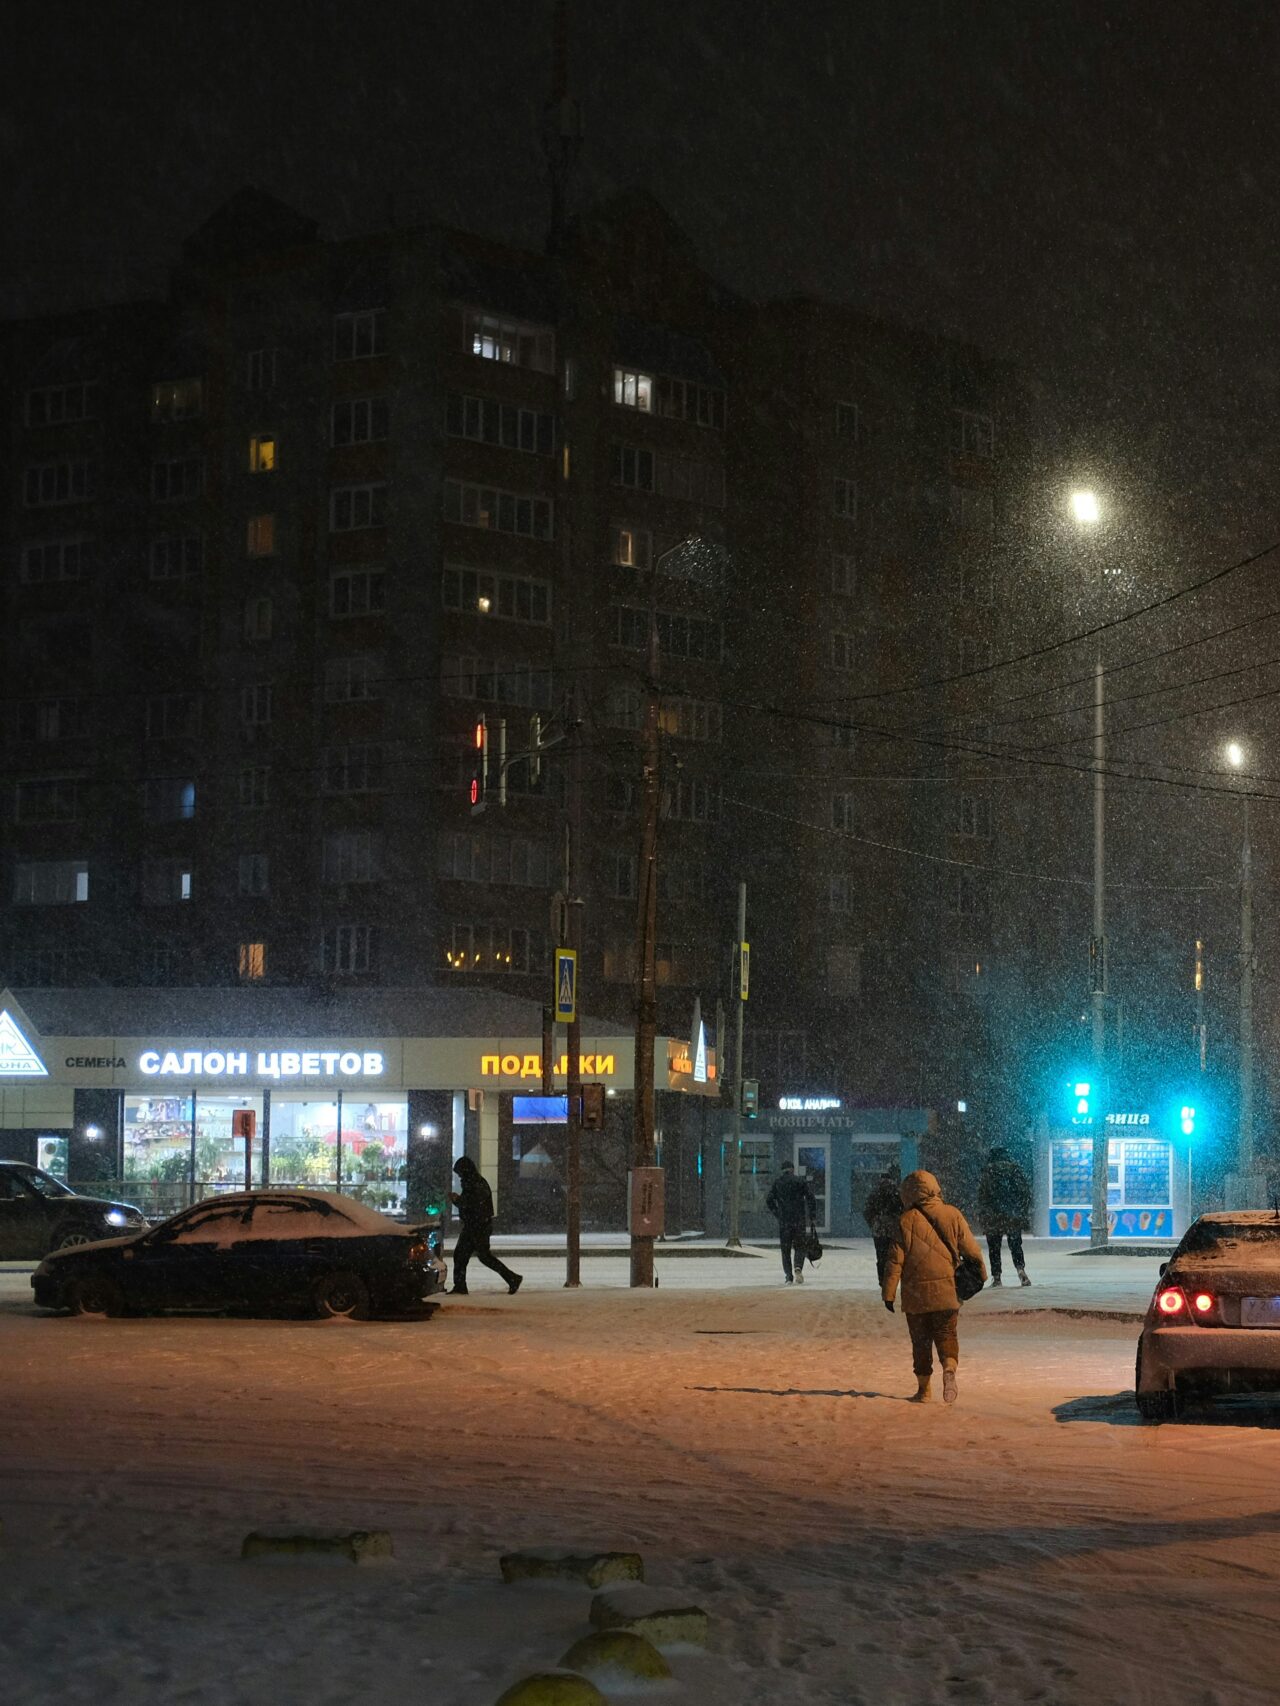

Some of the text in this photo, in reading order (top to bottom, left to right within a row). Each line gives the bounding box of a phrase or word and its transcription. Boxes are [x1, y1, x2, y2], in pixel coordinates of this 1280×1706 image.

[65, 1057, 126, 1068] СЕМЕНА
[139, 1052, 384, 1079] САЛОН ЦВЕТОВ
